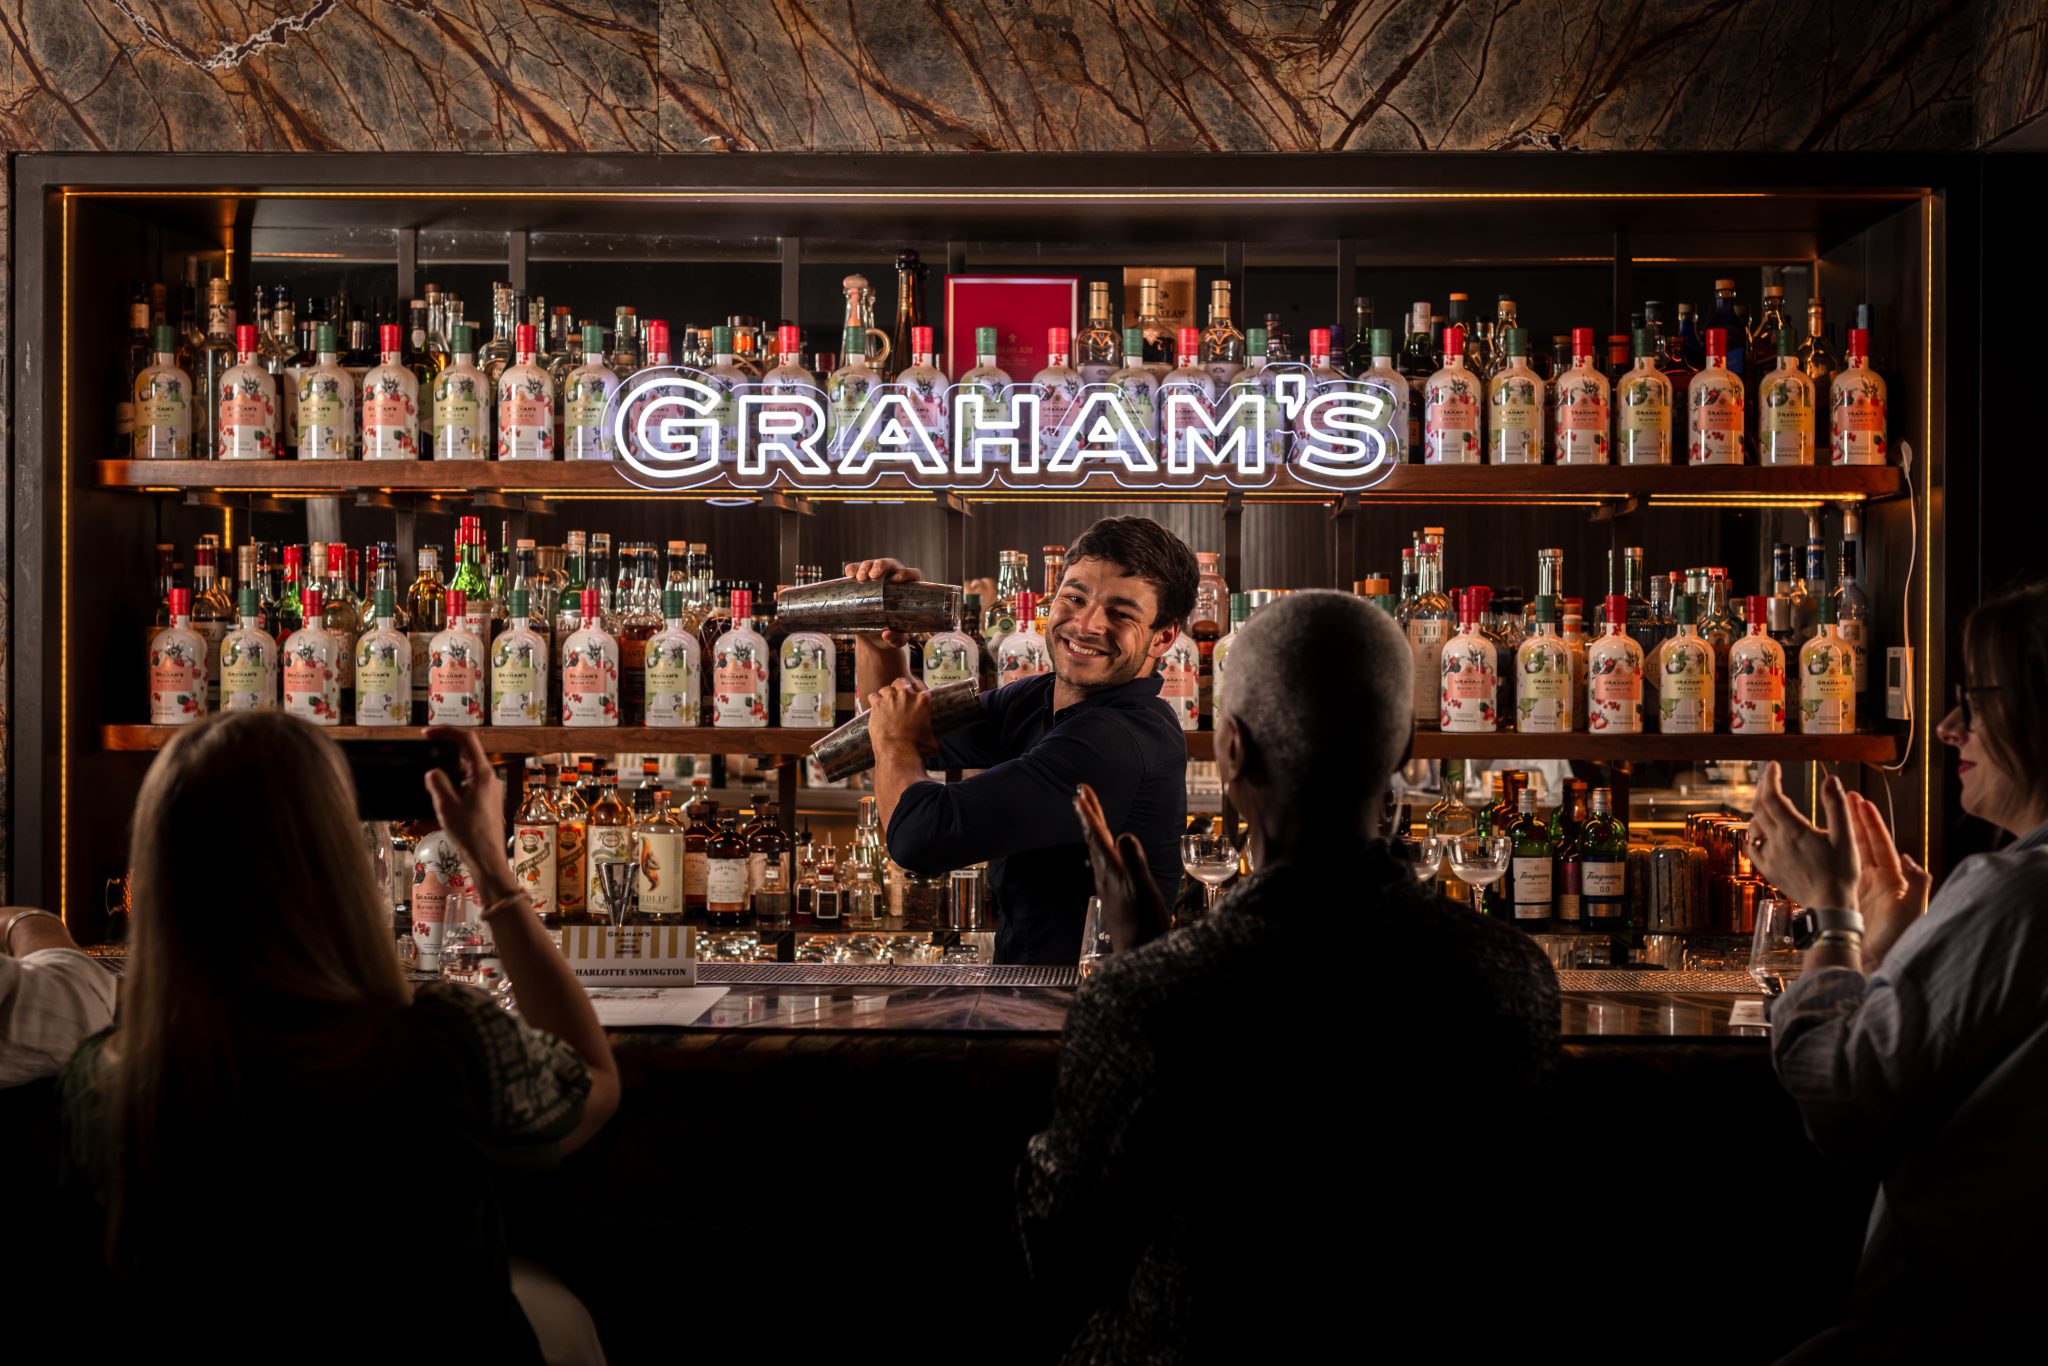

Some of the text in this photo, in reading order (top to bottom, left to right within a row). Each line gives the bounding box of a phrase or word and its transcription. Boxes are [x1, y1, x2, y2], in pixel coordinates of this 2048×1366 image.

[1134, 310, 1187, 318] MALLAN
[613, 374, 1389, 479] GRAHAM'S
[1586, 871, 1622, 882] Tanqueray
[575, 968, 687, 976] HARLOTTE SYMINGTON
